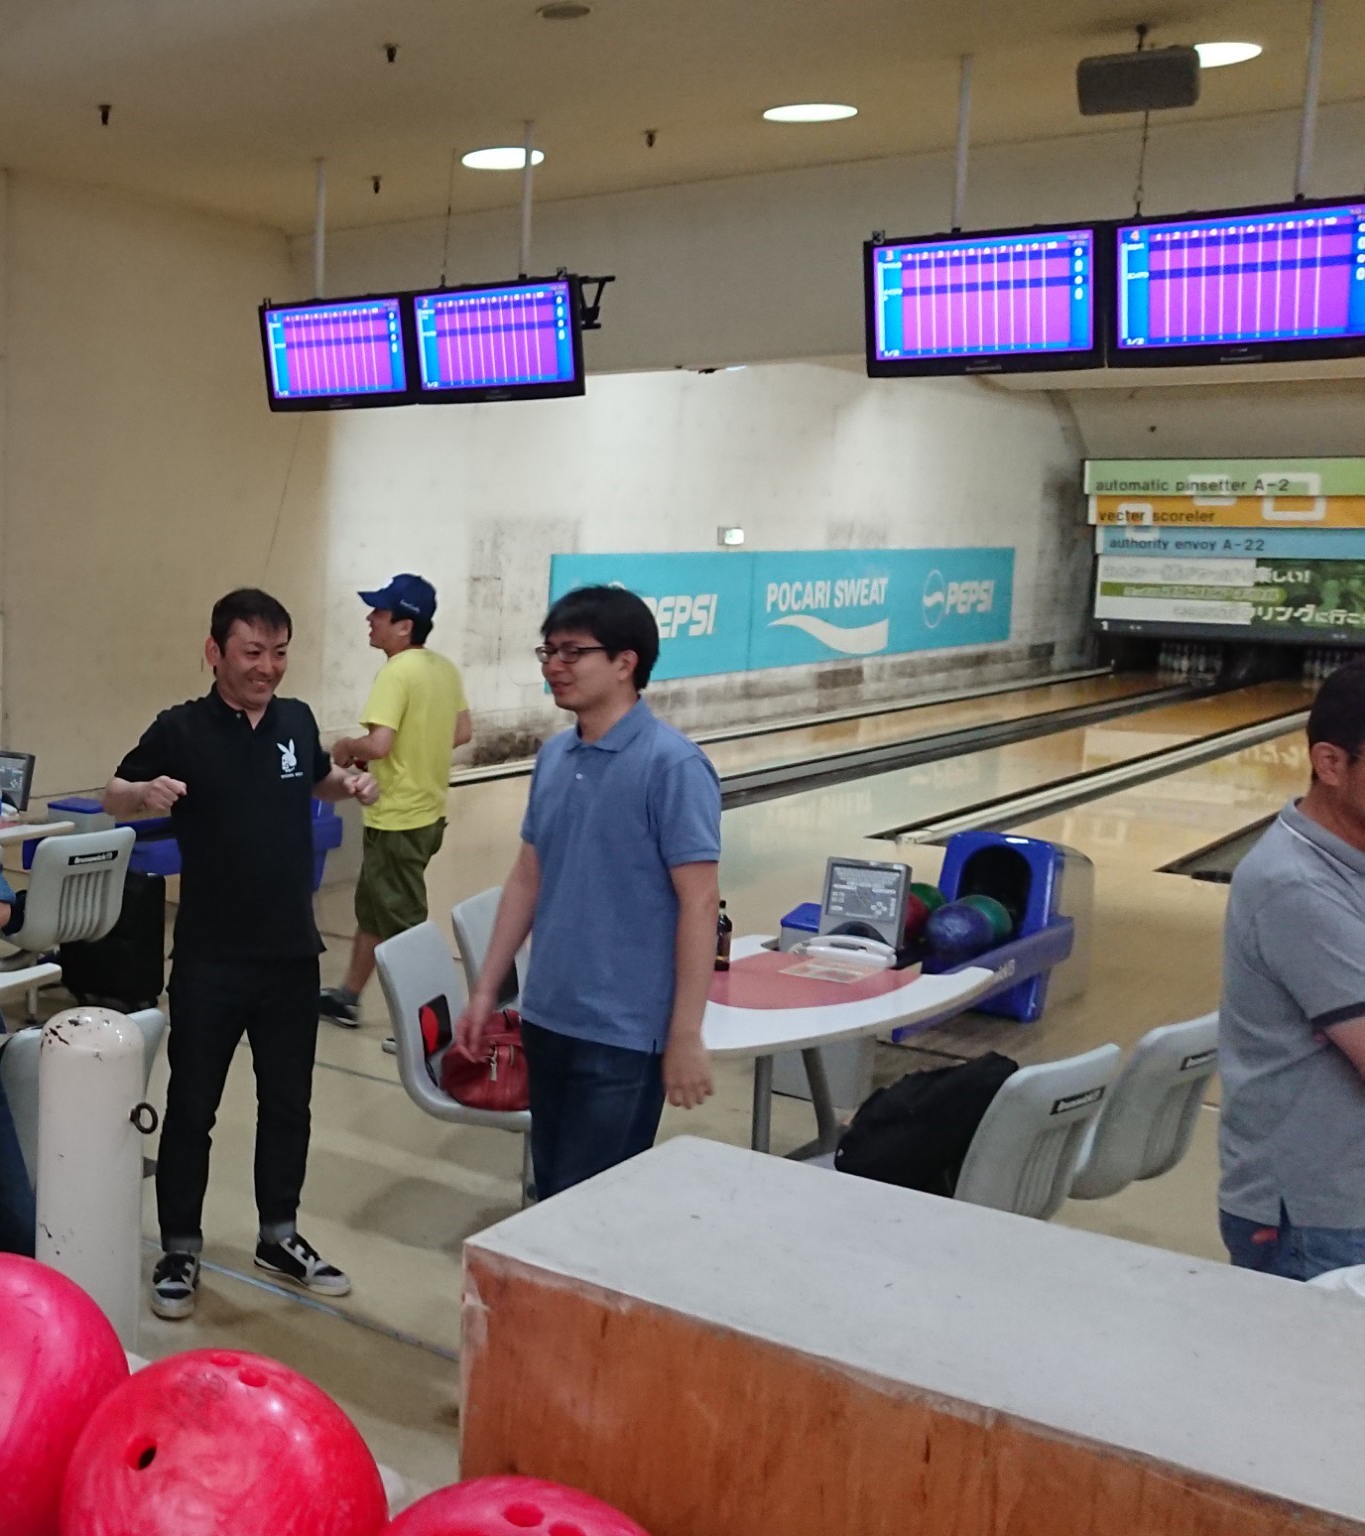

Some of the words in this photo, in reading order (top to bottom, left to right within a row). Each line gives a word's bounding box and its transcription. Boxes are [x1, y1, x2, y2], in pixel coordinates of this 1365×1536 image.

[1096, 480, 1169, 491] automatic
[1175, 480, 1247, 493] pinsetter
[1254, 479, 1289, 491] A-2
[1110, 538, 1170, 551] authority
[1175, 541, 1216, 551] envoy
[766, 580, 831, 613] POCARI
[834, 577, 889, 609] SWEAT
[945, 580, 995, 615] PEPSI
